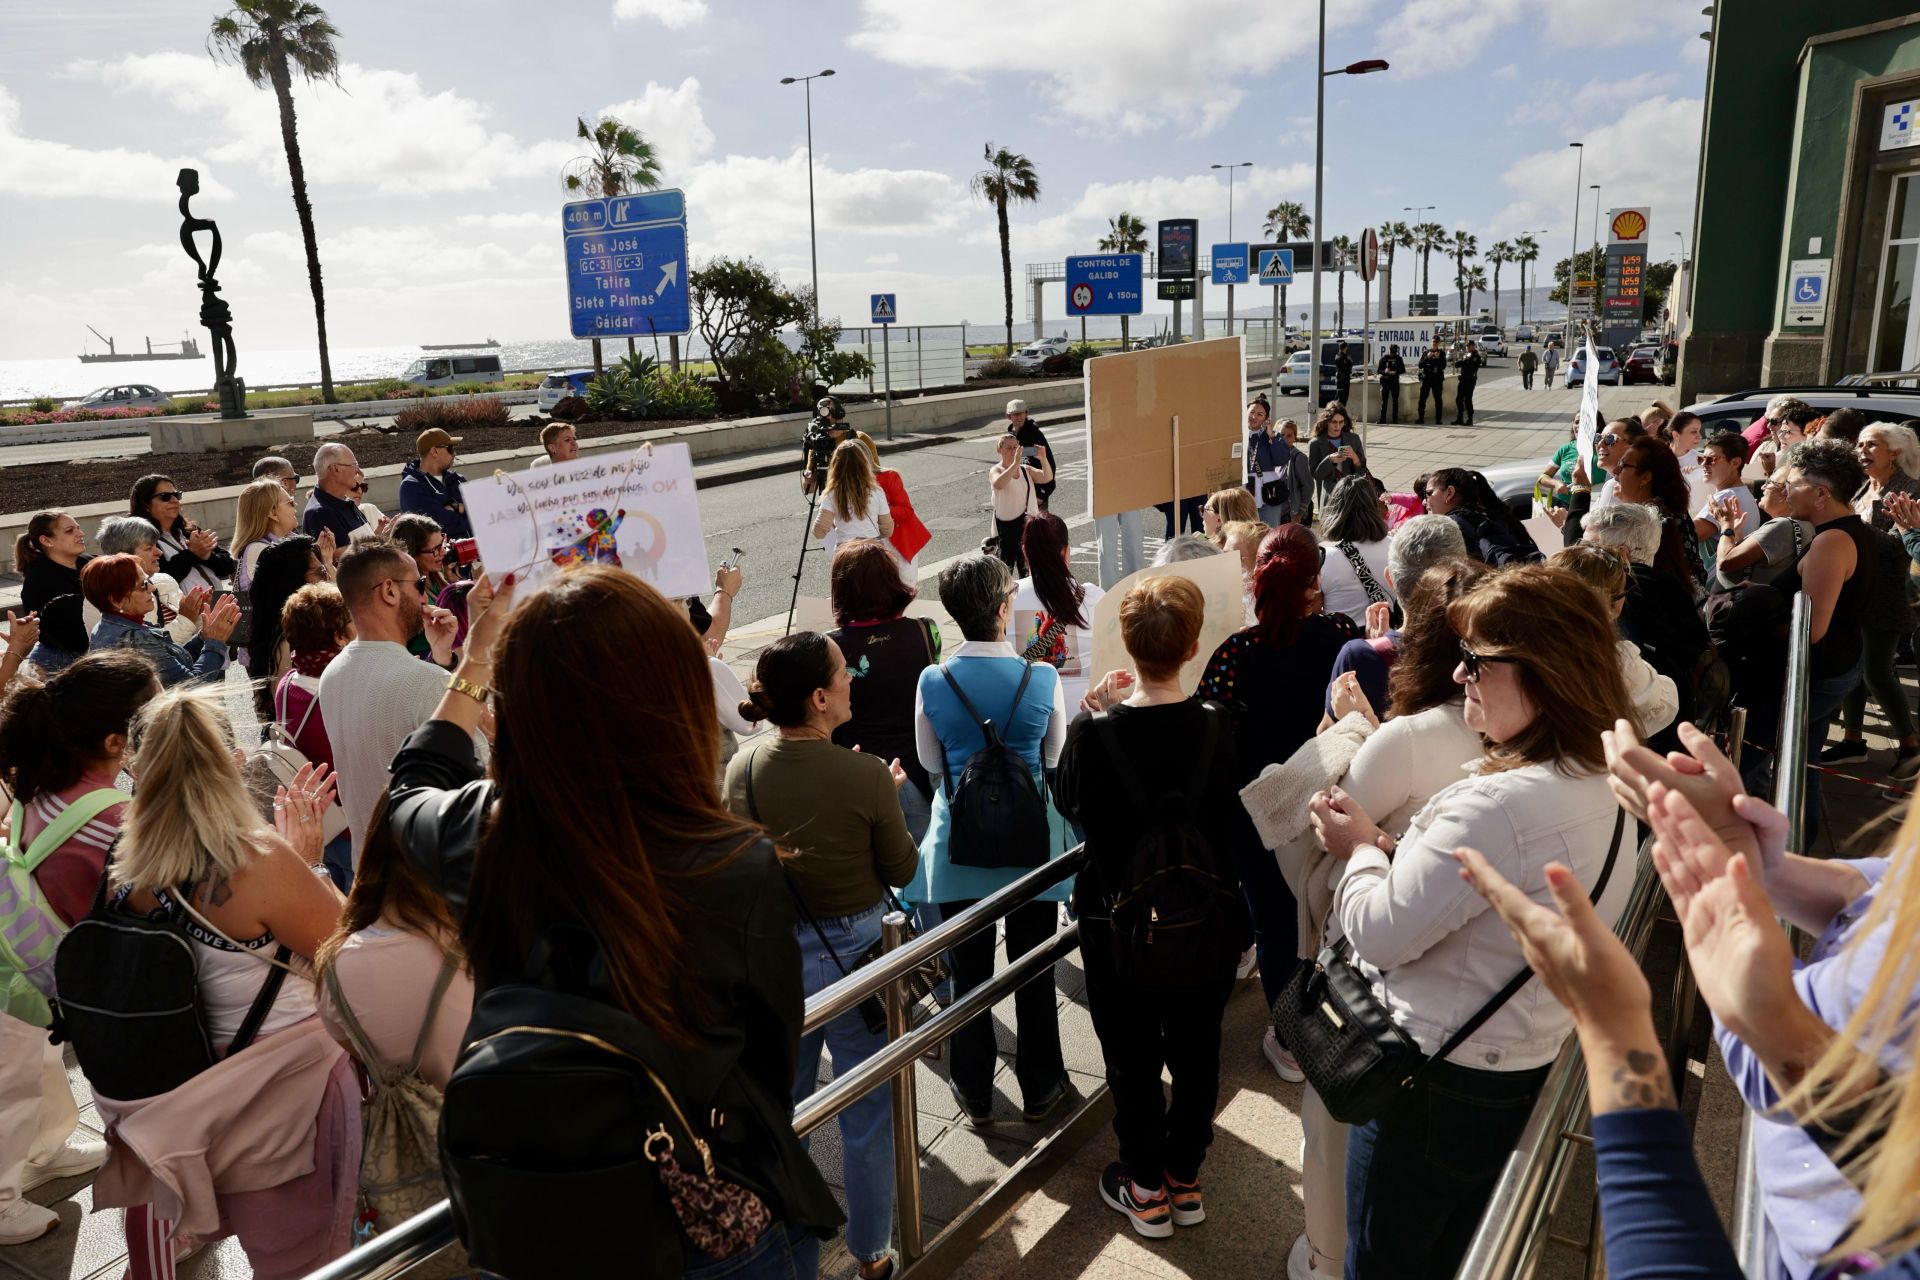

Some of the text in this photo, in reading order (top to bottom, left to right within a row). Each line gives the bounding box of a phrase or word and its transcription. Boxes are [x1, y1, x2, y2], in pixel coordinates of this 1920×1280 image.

[568, 211, 602, 223] 400 m
[582, 236, 638, 255] San José
[582, 259, 610, 272] GC-31
[616, 256, 641, 268] GC-3
[1077, 260, 1117, 268] CONTROL
[595, 276, 630, 289] Tafira
[1088, 272, 1119, 280] GALIBO
[575, 293, 655, 309] Siete Palmas
[1107, 292, 1114, 300] A
[595, 314, 633, 328] Gáldar
[1379, 330, 1430, 341] ENTRADA AL
[1381, 346, 1427, 357] PKING
[528, 479, 549, 490] soy
[593, 465, 606, 479] de
[611, 463, 626, 475] mi
[630, 458, 650, 476] hijo
[562, 494, 579, 507] por
[186, 922, 223, 948] LOVE
